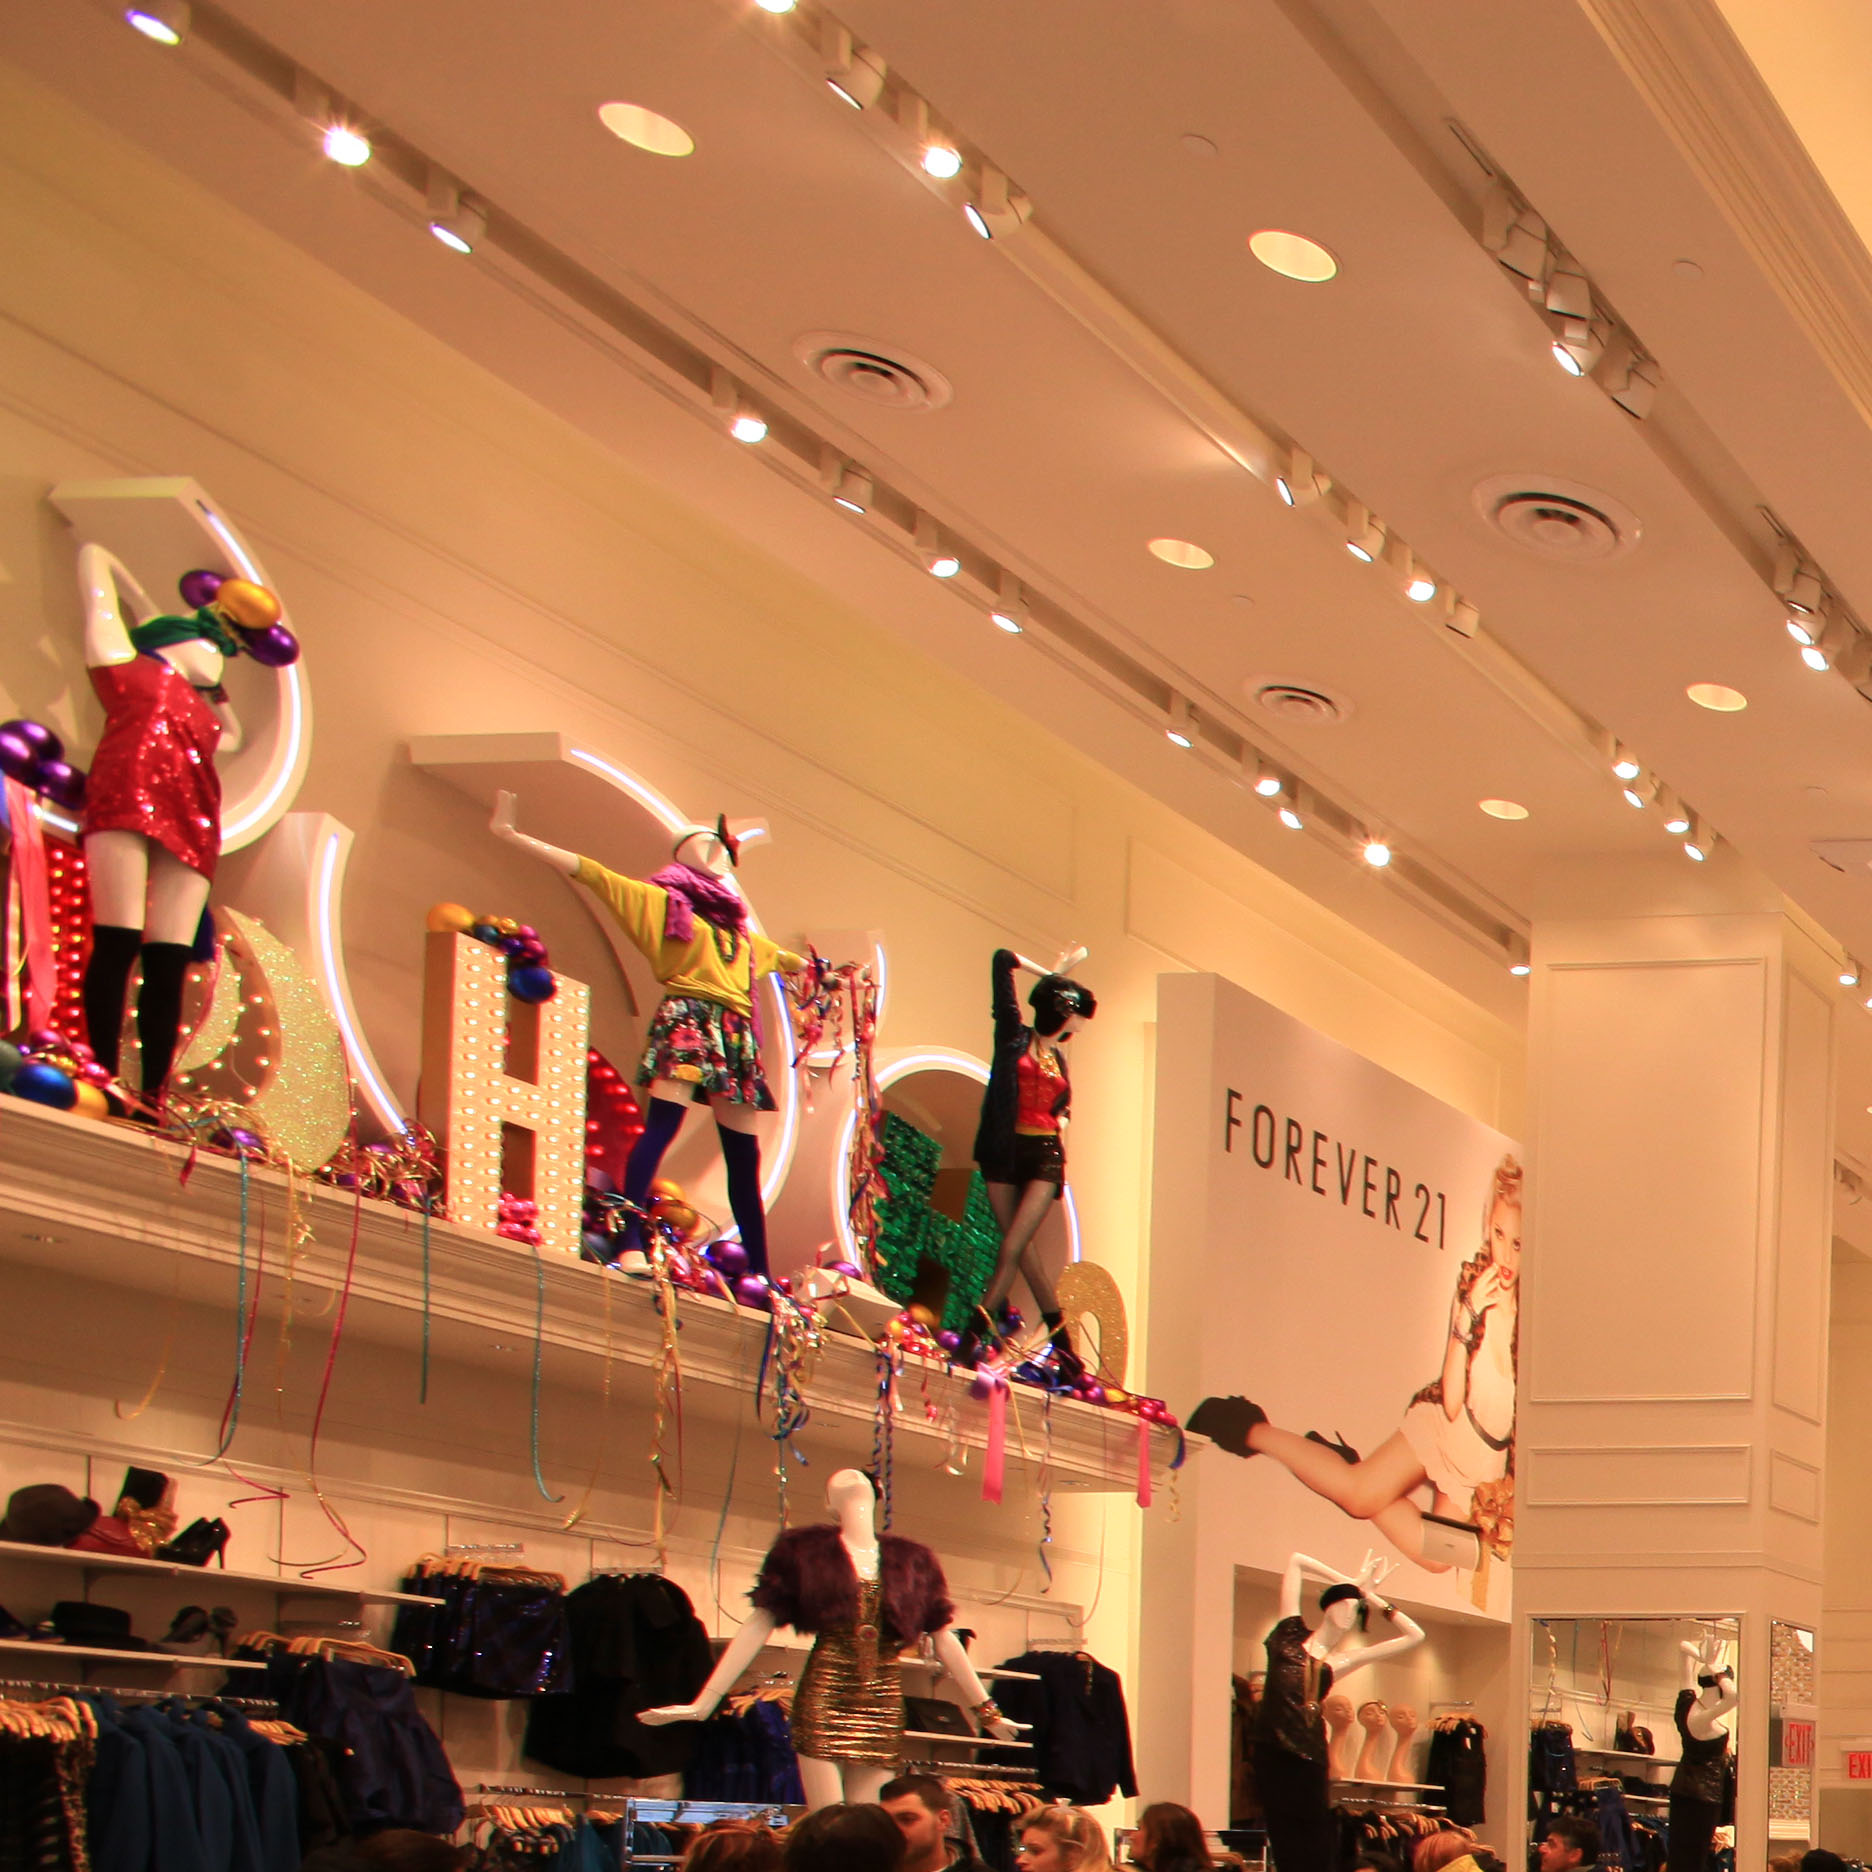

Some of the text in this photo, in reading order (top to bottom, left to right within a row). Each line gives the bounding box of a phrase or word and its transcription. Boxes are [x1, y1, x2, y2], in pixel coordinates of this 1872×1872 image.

[1223, 1087, 1447, 1251] FOREVER 21
[1788, 1721, 1813, 1766] EXIT
